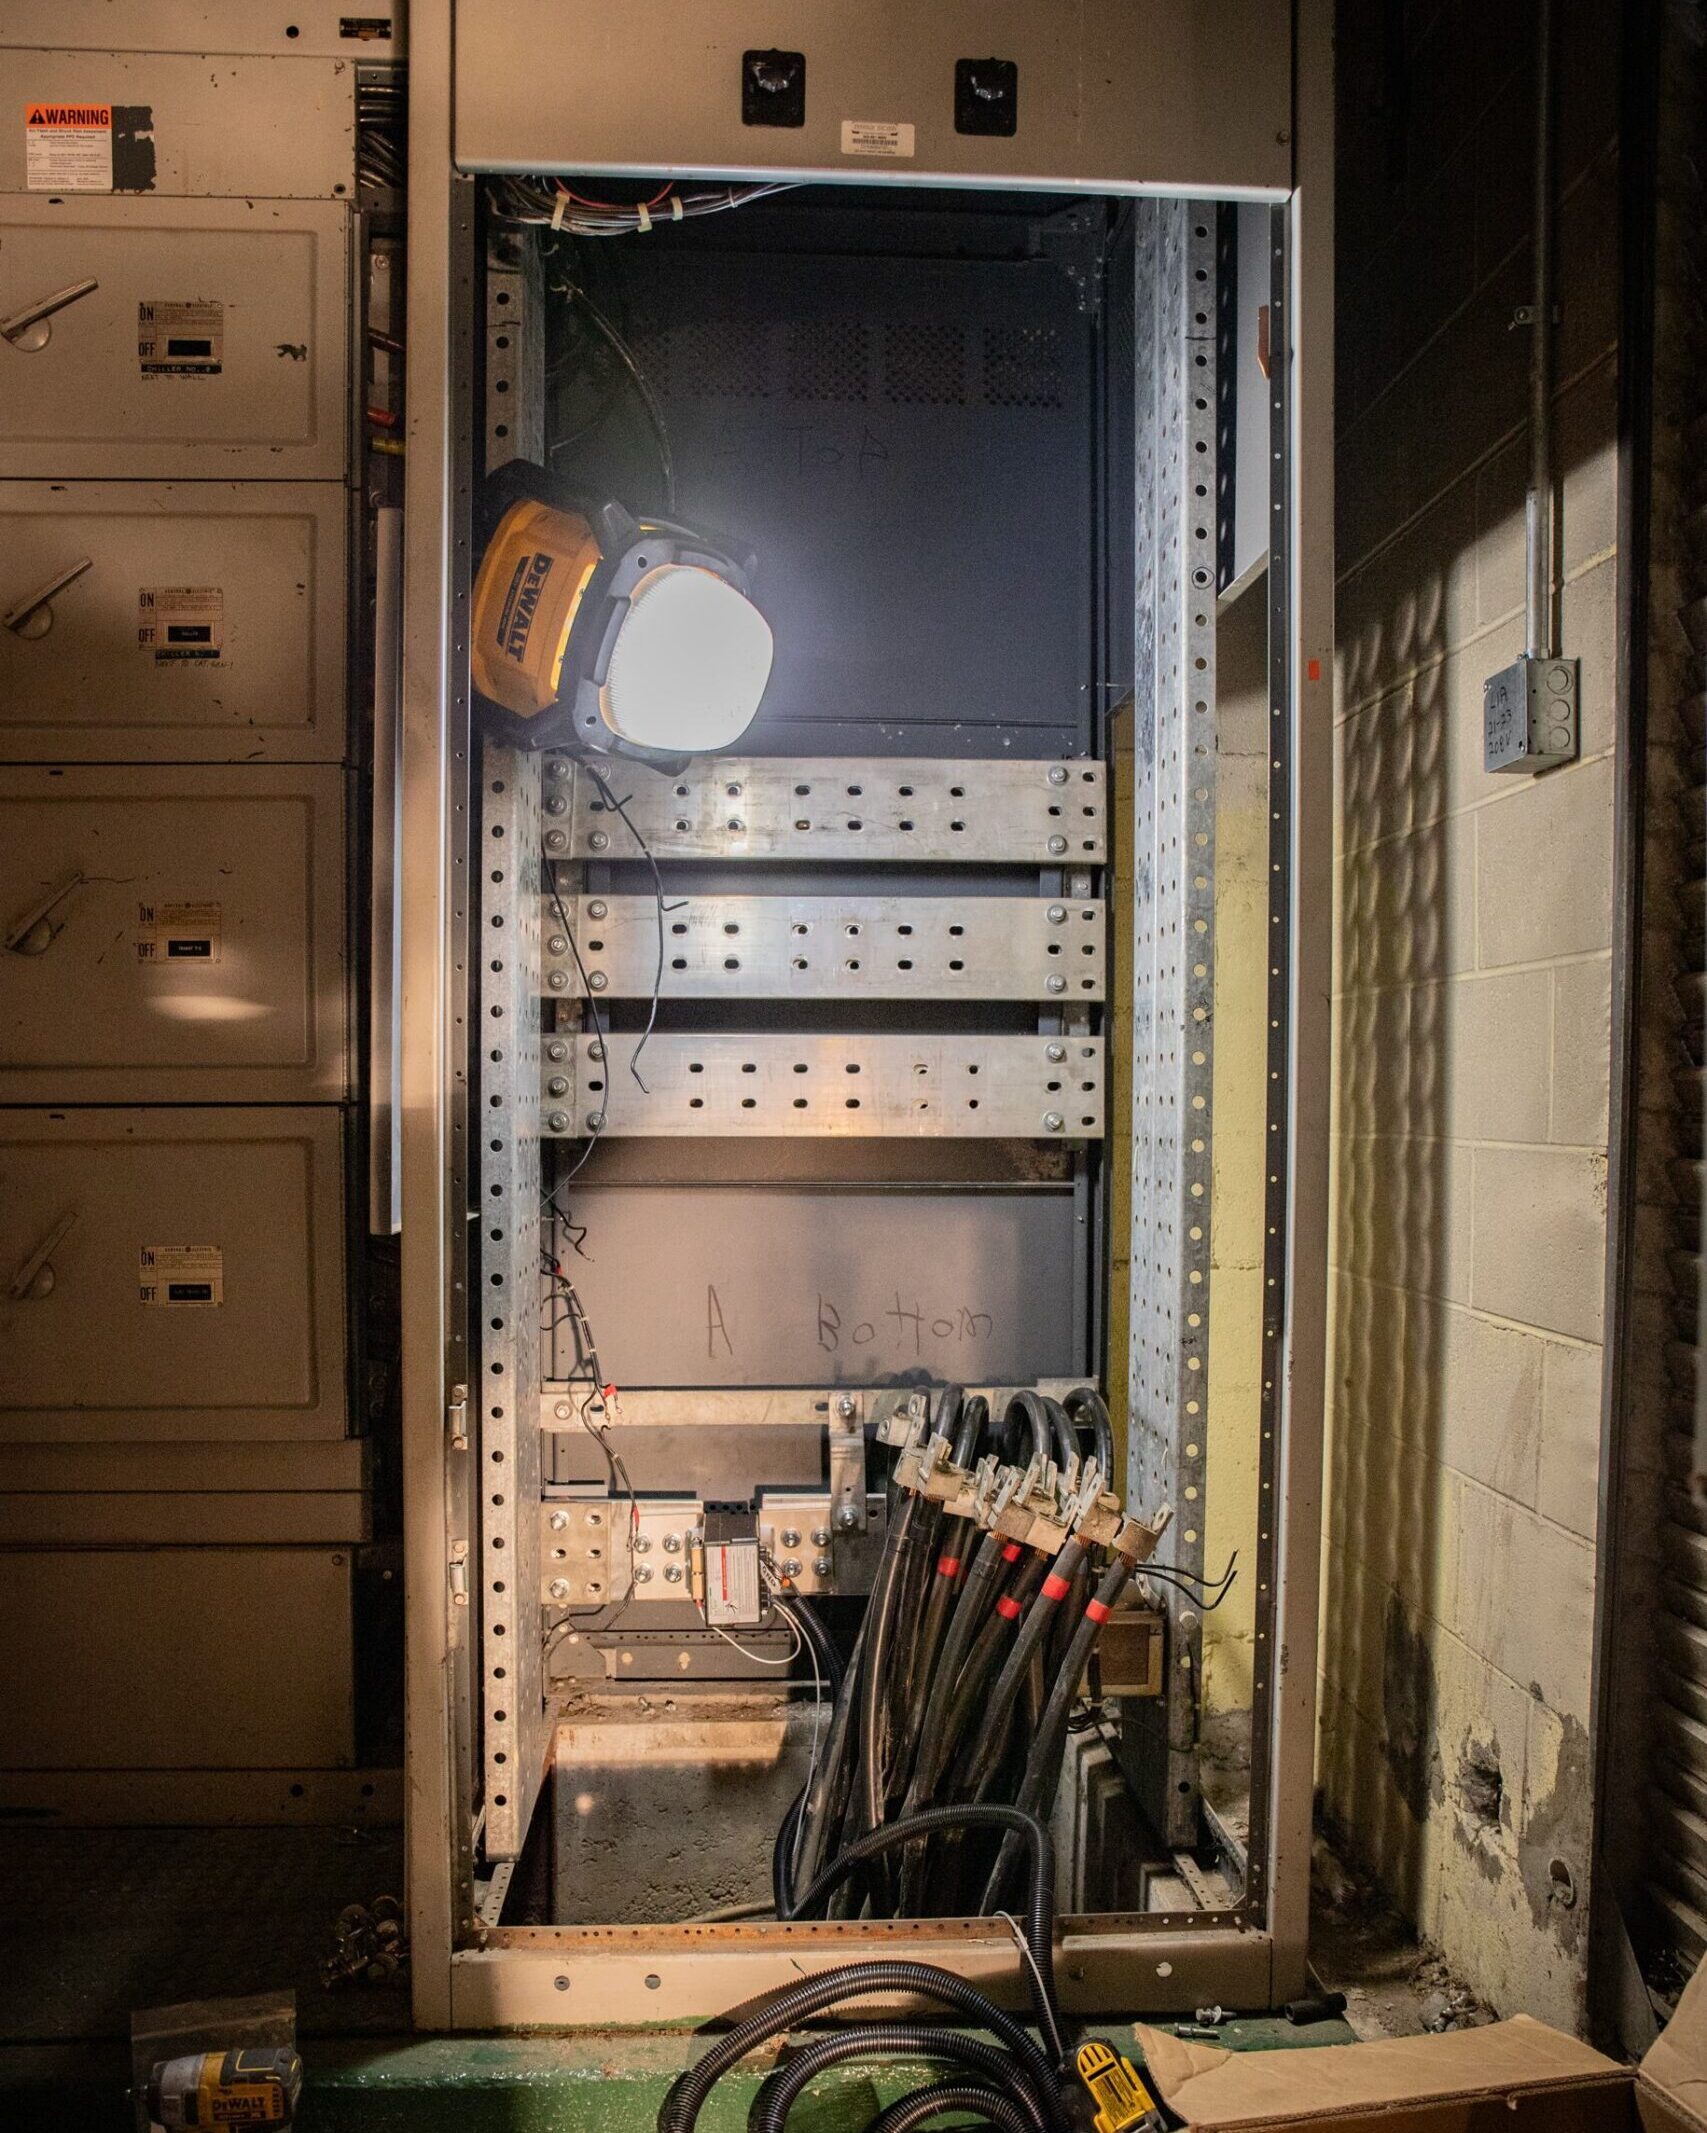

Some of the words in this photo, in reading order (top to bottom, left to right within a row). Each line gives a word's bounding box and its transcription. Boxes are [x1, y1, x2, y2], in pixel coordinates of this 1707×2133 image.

[45, 109, 109, 125] WARNING
[139, 306, 154, 321] ON
[138, 342, 156, 357] OFF
[140, 593, 154, 608] ON
[507, 552, 554, 664] DEWALT
[138, 628, 155, 642] OFF
[139, 906, 154, 922] ON
[138, 943, 156, 958] OFF
[140, 1251, 155, 1266] ON
[140, 1286, 158, 1301] OFF
[706, 1284, 733, 1358] A
